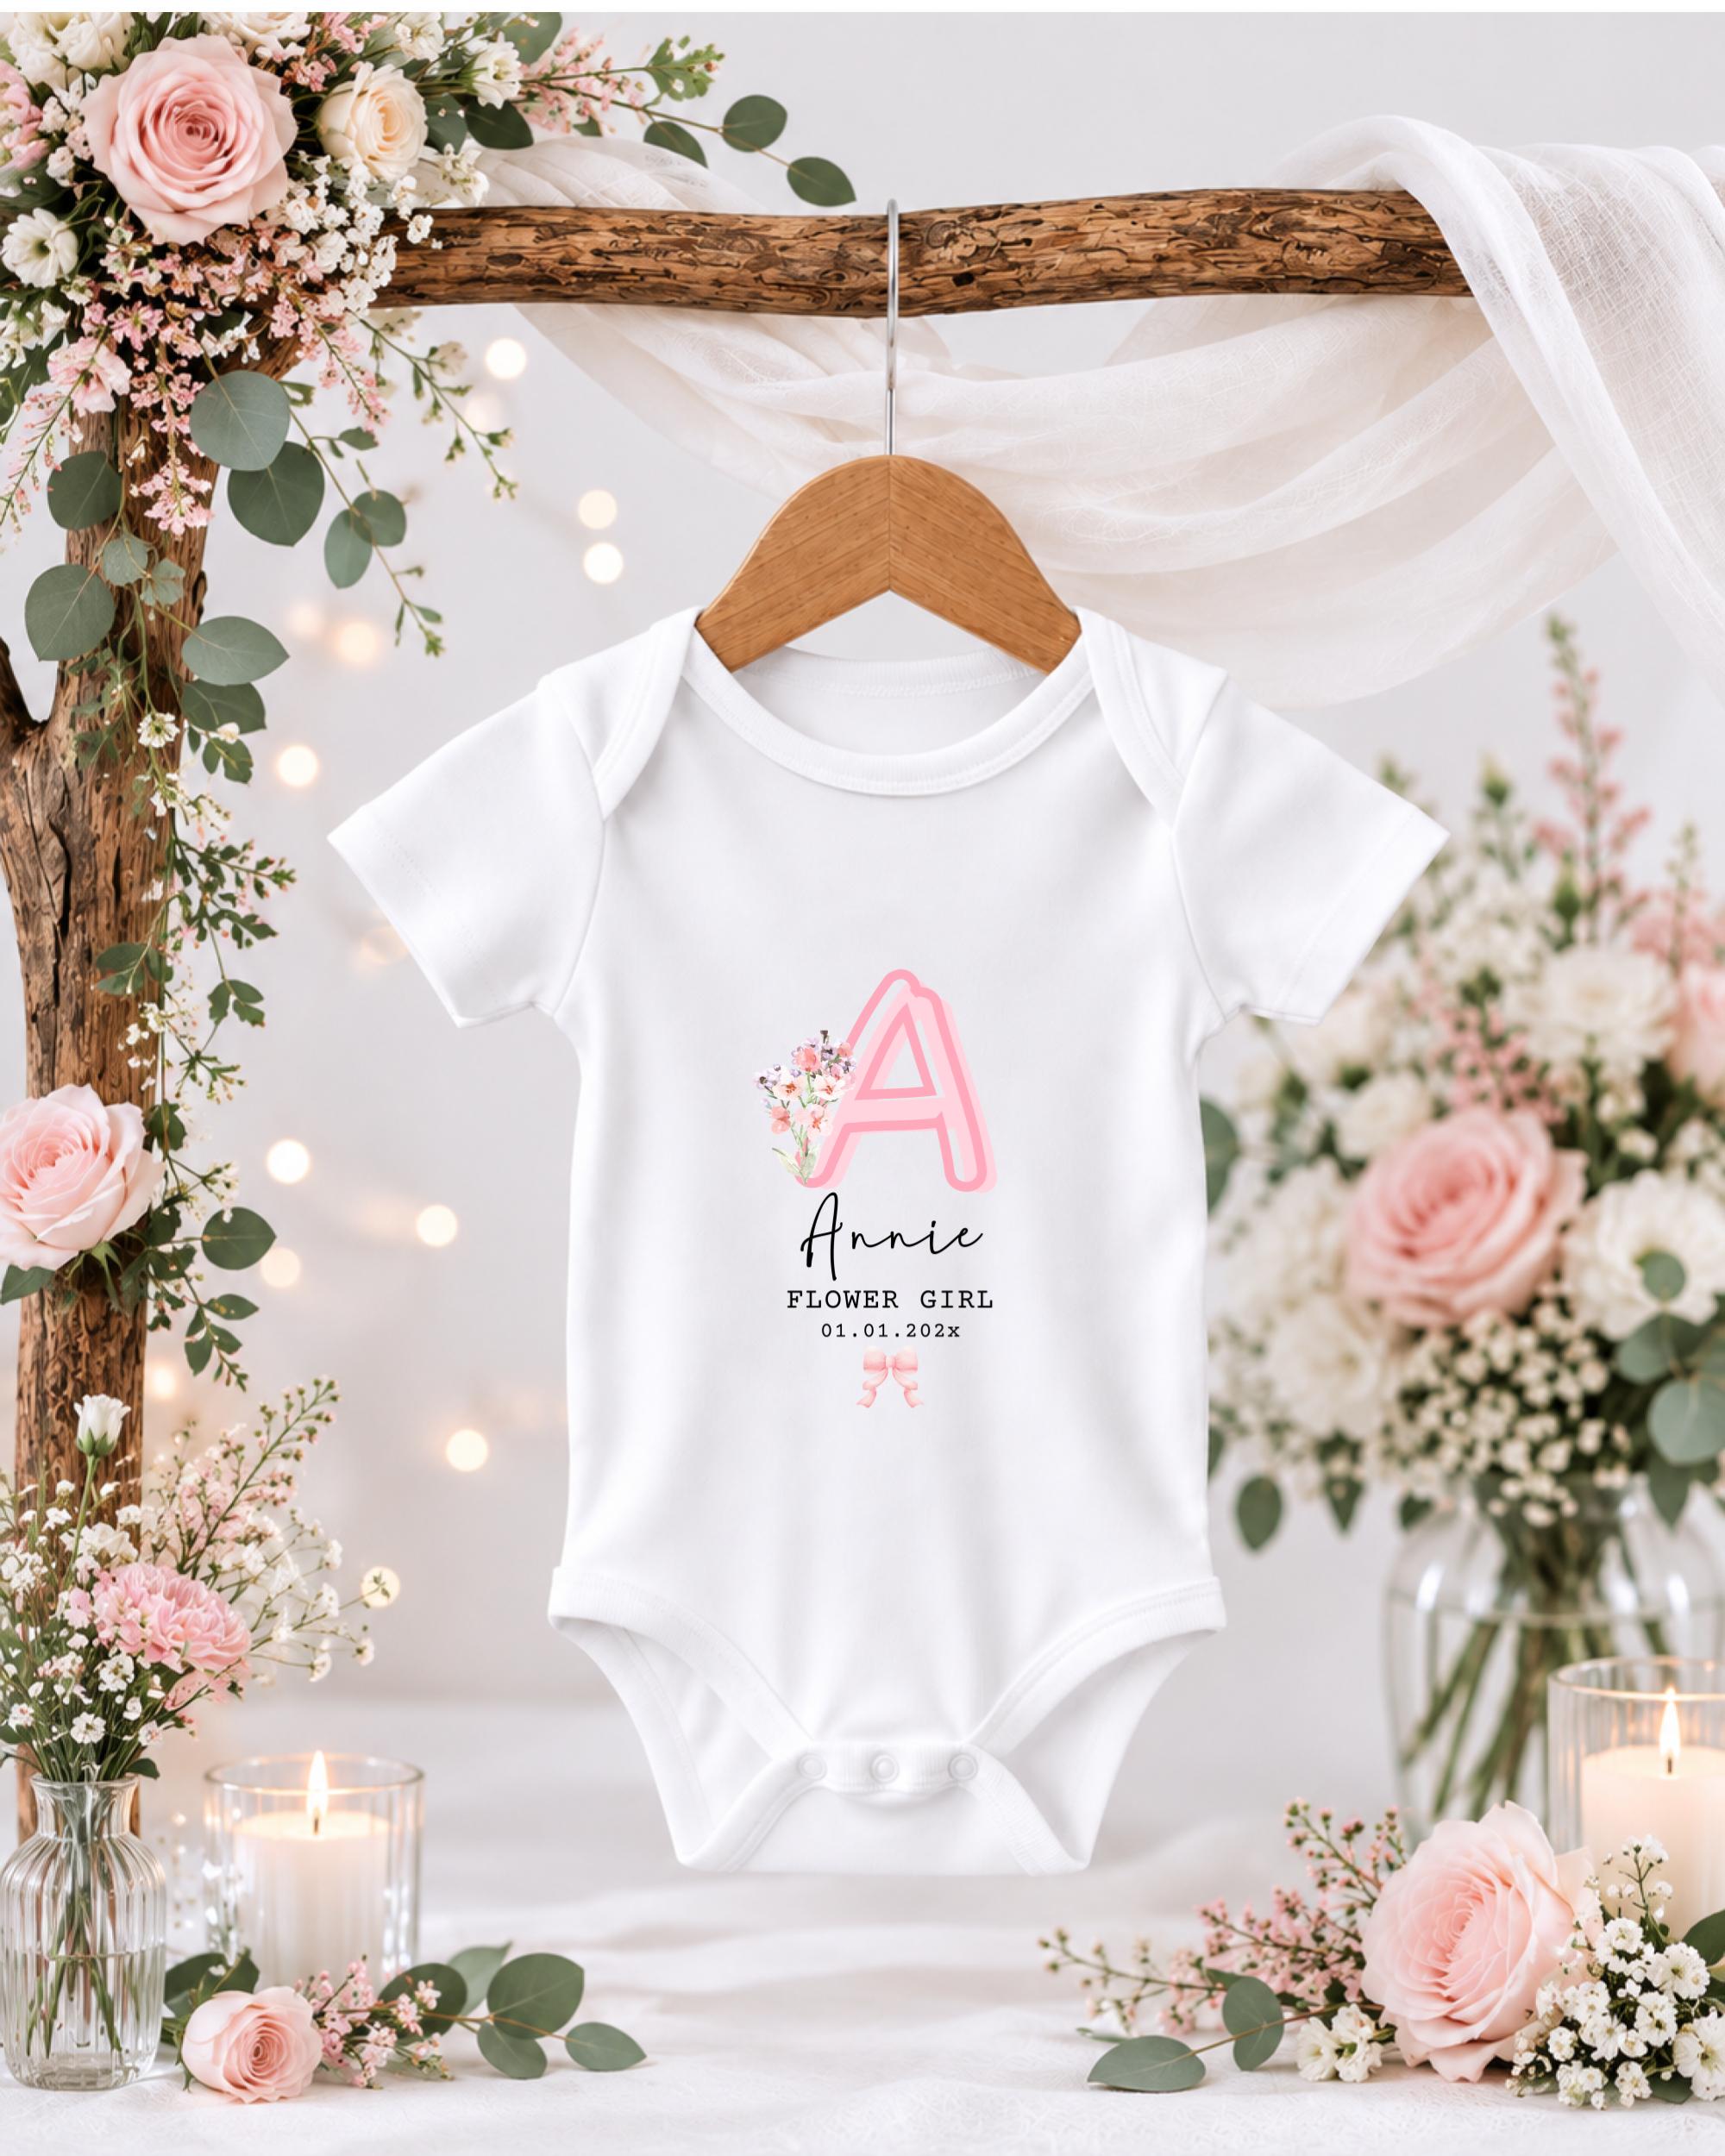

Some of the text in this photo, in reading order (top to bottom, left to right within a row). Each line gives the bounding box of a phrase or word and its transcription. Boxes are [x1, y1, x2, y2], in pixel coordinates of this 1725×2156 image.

[794, 968, 998, 1193] A
[800, 1192, 984, 1282] Annie
[787, 1289, 994, 1309] FLOWER GIRL
[821, 1323, 961, 1338] 01.01.202x
